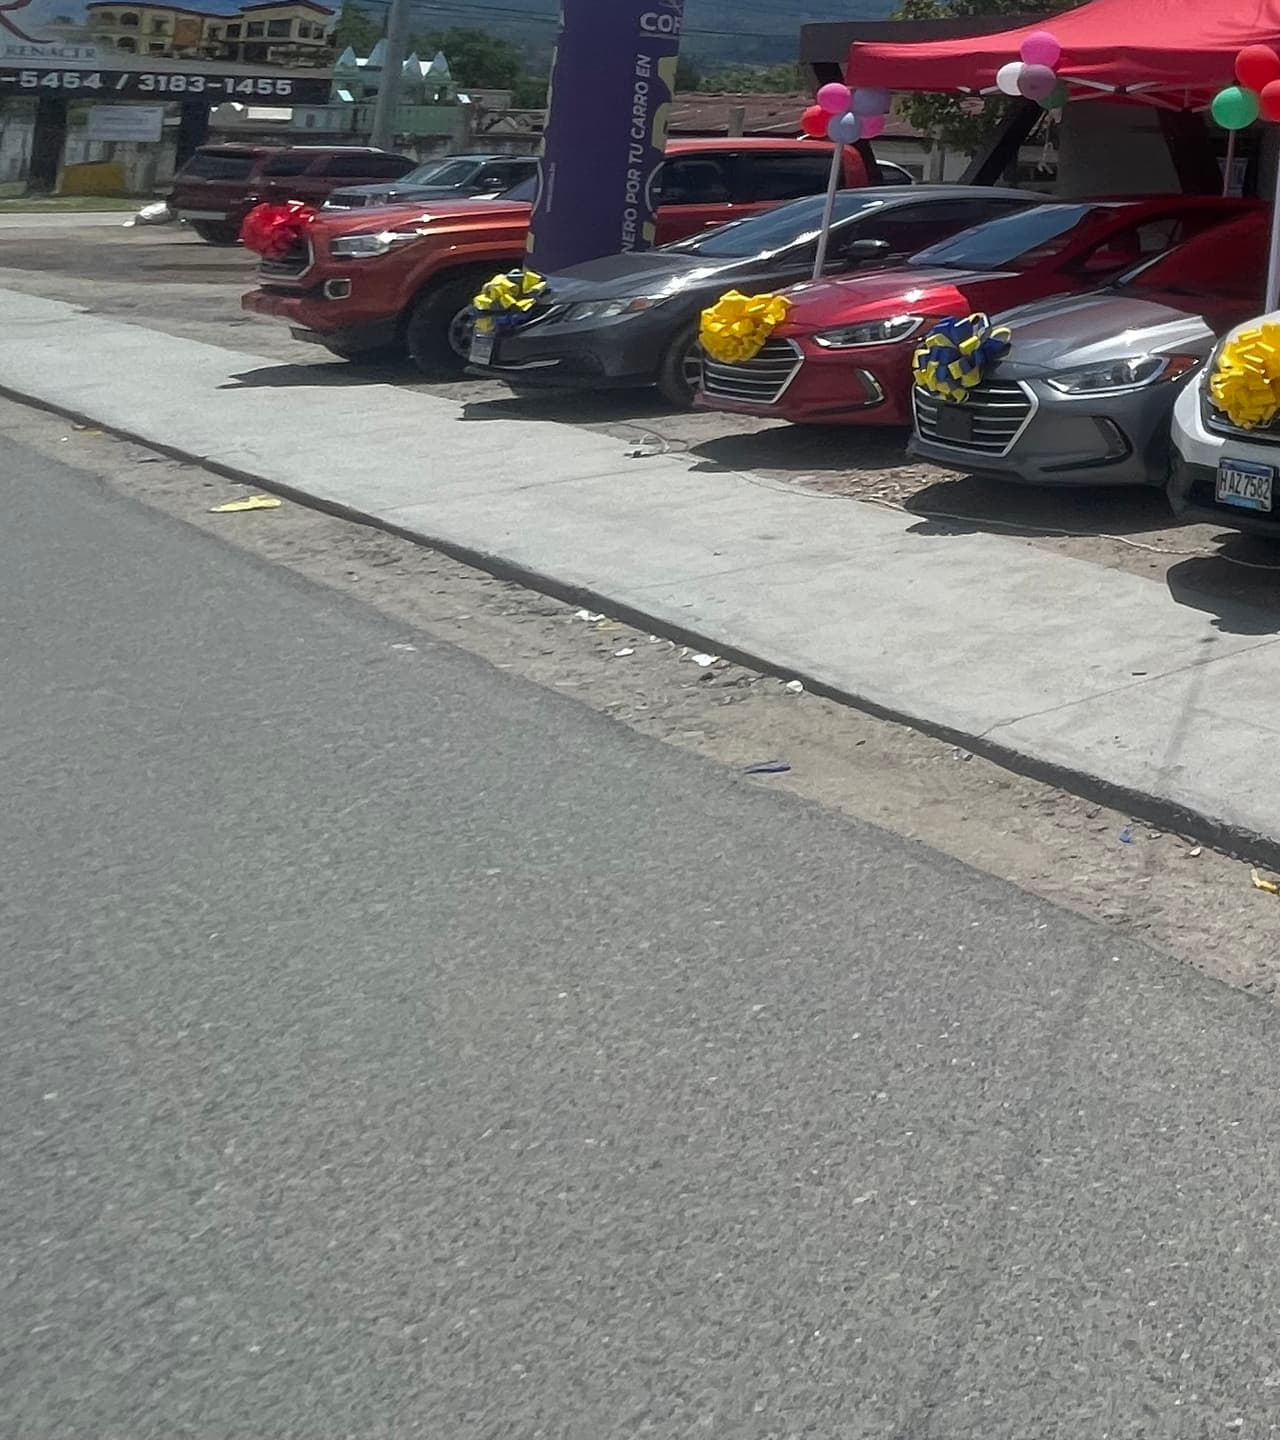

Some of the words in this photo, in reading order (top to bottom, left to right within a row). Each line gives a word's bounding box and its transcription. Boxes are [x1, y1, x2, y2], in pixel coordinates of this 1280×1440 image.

[635, 53, 651, 78] EN
[137, 74, 293, 96] 3183-1455
[631, 81, 649, 139] CARRO
[628, 142, 644, 164] TU
[625, 168, 641, 204] POR
